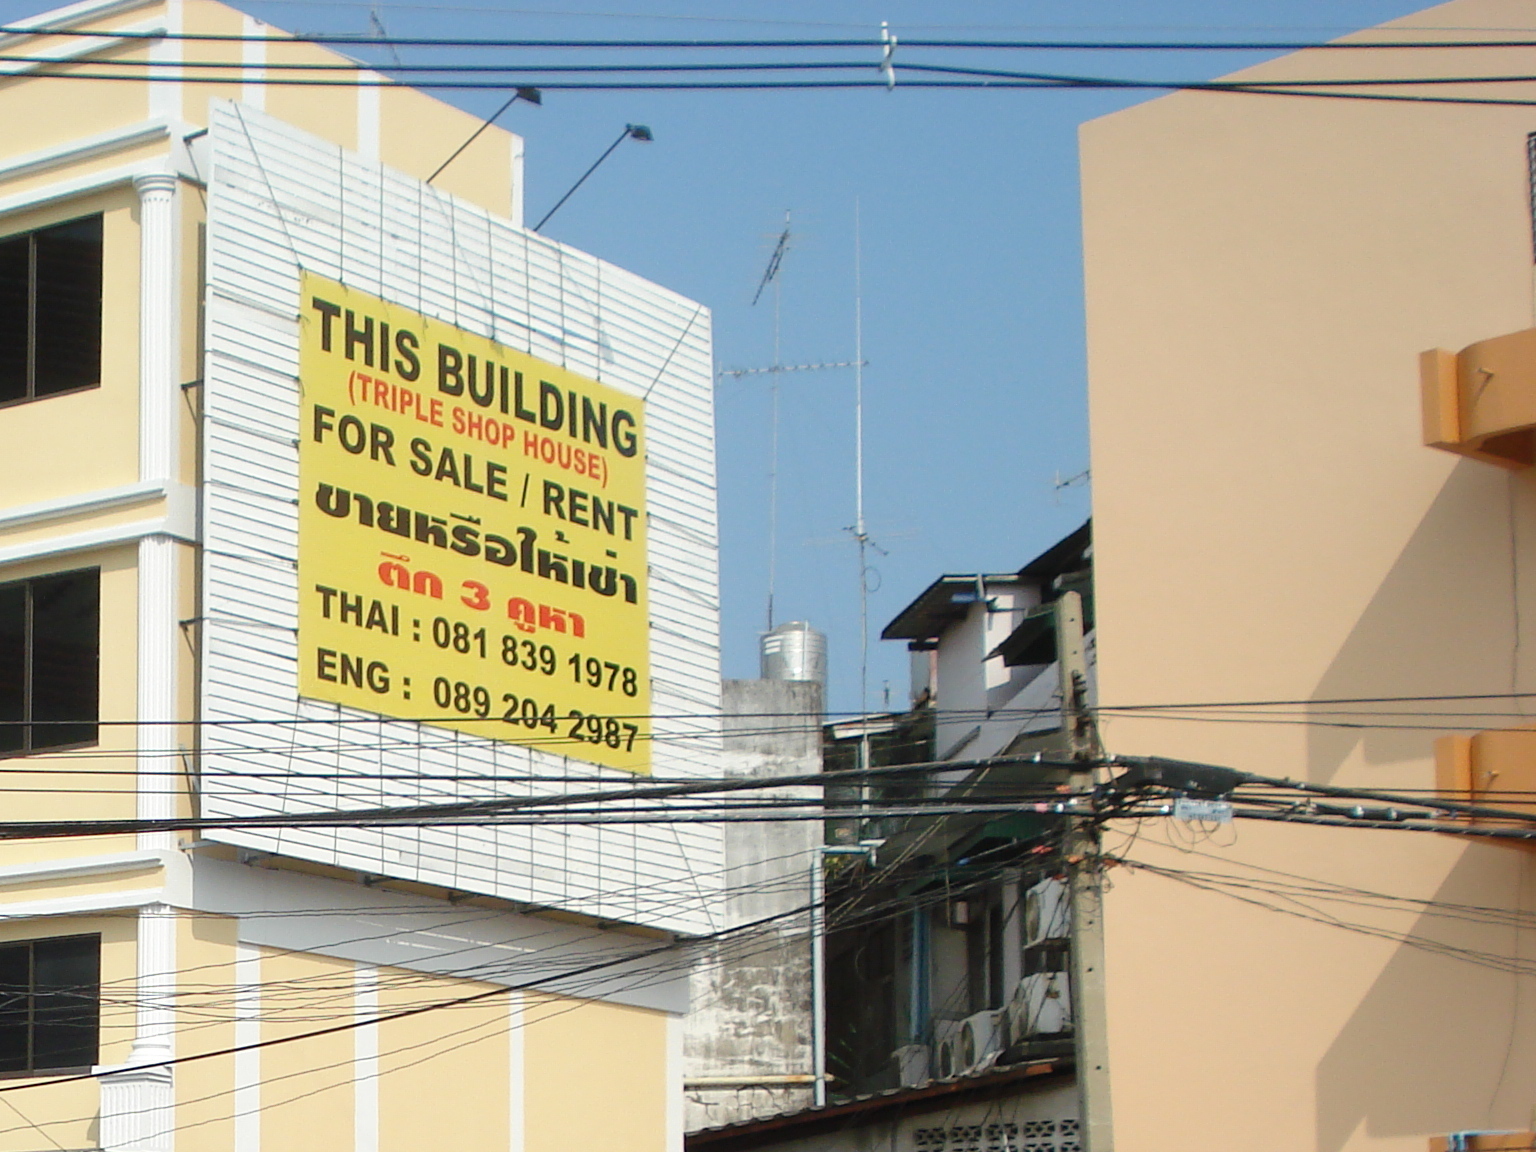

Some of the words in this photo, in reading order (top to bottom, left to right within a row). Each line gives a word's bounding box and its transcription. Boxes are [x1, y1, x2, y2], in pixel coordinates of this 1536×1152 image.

[313, 296, 421, 382] THIS
[438, 343, 637, 457] BUILDING
[349, 370, 443, 427] (TRIPLE
[452, 407, 515, 449] SHOP
[524, 430, 608, 488] HOUSE)
[314, 404, 396, 466] FOR
[410, 437, 507, 501] SALE
[521, 473, 529, 508] /
[543, 479, 638, 540] RENT
[316, 482, 637, 605] ขายหรือให้เช่า
[378, 551, 443, 599] ตึก
[461, 579, 491, 611] 3
[508, 597, 584, 638] คูหา
[316, 584, 398, 636] THAI
[433, 617, 486, 658] 081
[502, 635, 556, 676] 839
[568, 653, 637, 697] 1978
[318, 647, 389, 694] ENG
[434, 677, 490, 720] 089
[503, 694, 558, 735] 204
[569, 710, 638, 753] 2987
